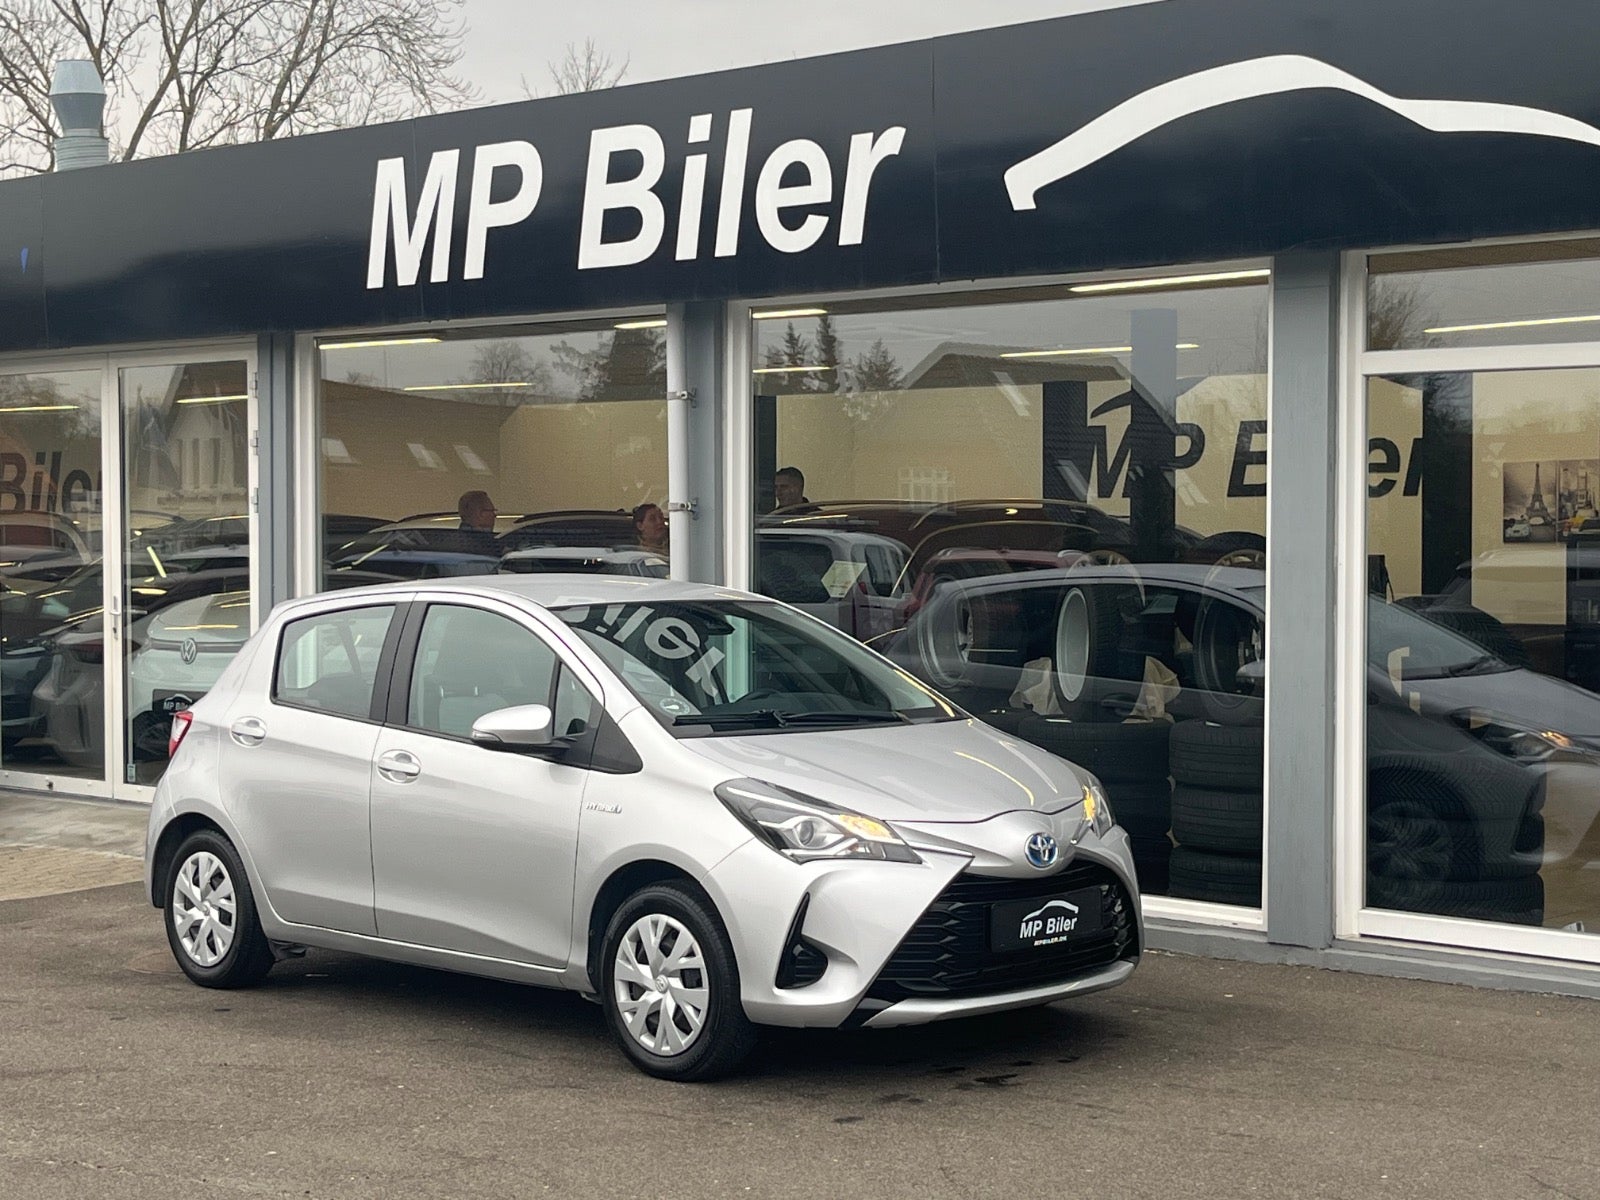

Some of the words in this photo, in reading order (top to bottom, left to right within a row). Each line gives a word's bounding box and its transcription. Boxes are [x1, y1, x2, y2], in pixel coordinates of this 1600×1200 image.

[366, 140, 543, 289] MP
[578, 107, 907, 270] Biler
[0, 451, 102, 513] Bile
[1020, 920, 1043, 939] MP
[1046, 916, 1078, 935] Biler
